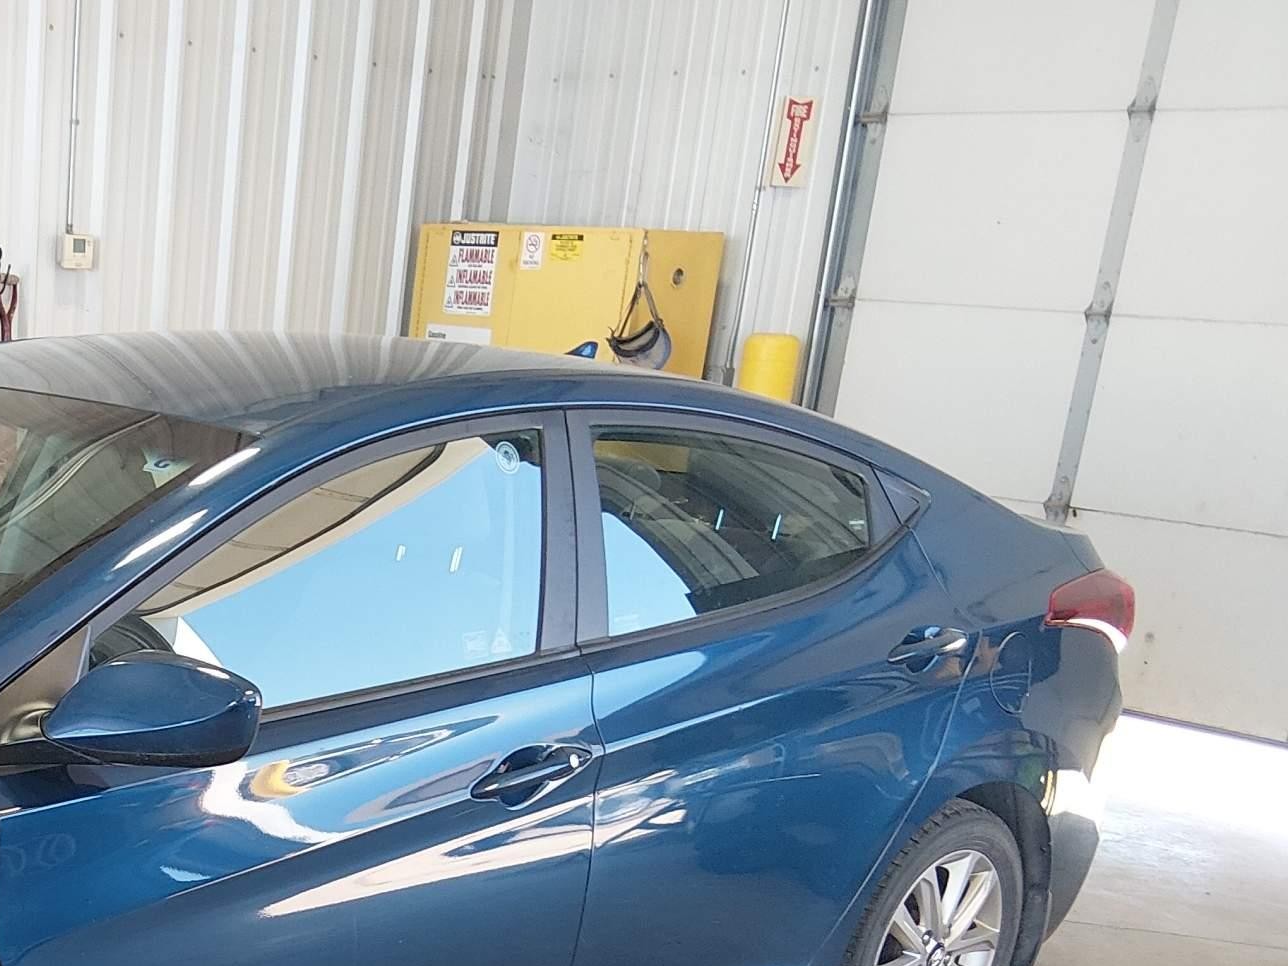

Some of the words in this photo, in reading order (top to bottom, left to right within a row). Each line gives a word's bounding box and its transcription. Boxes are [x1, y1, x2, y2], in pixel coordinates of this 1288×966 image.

[457, 247, 495, 264] FLAMMABLE
[455, 268, 493, 286] INFLAMABLE
[453, 289, 491, 307] INFLAMMABLE
